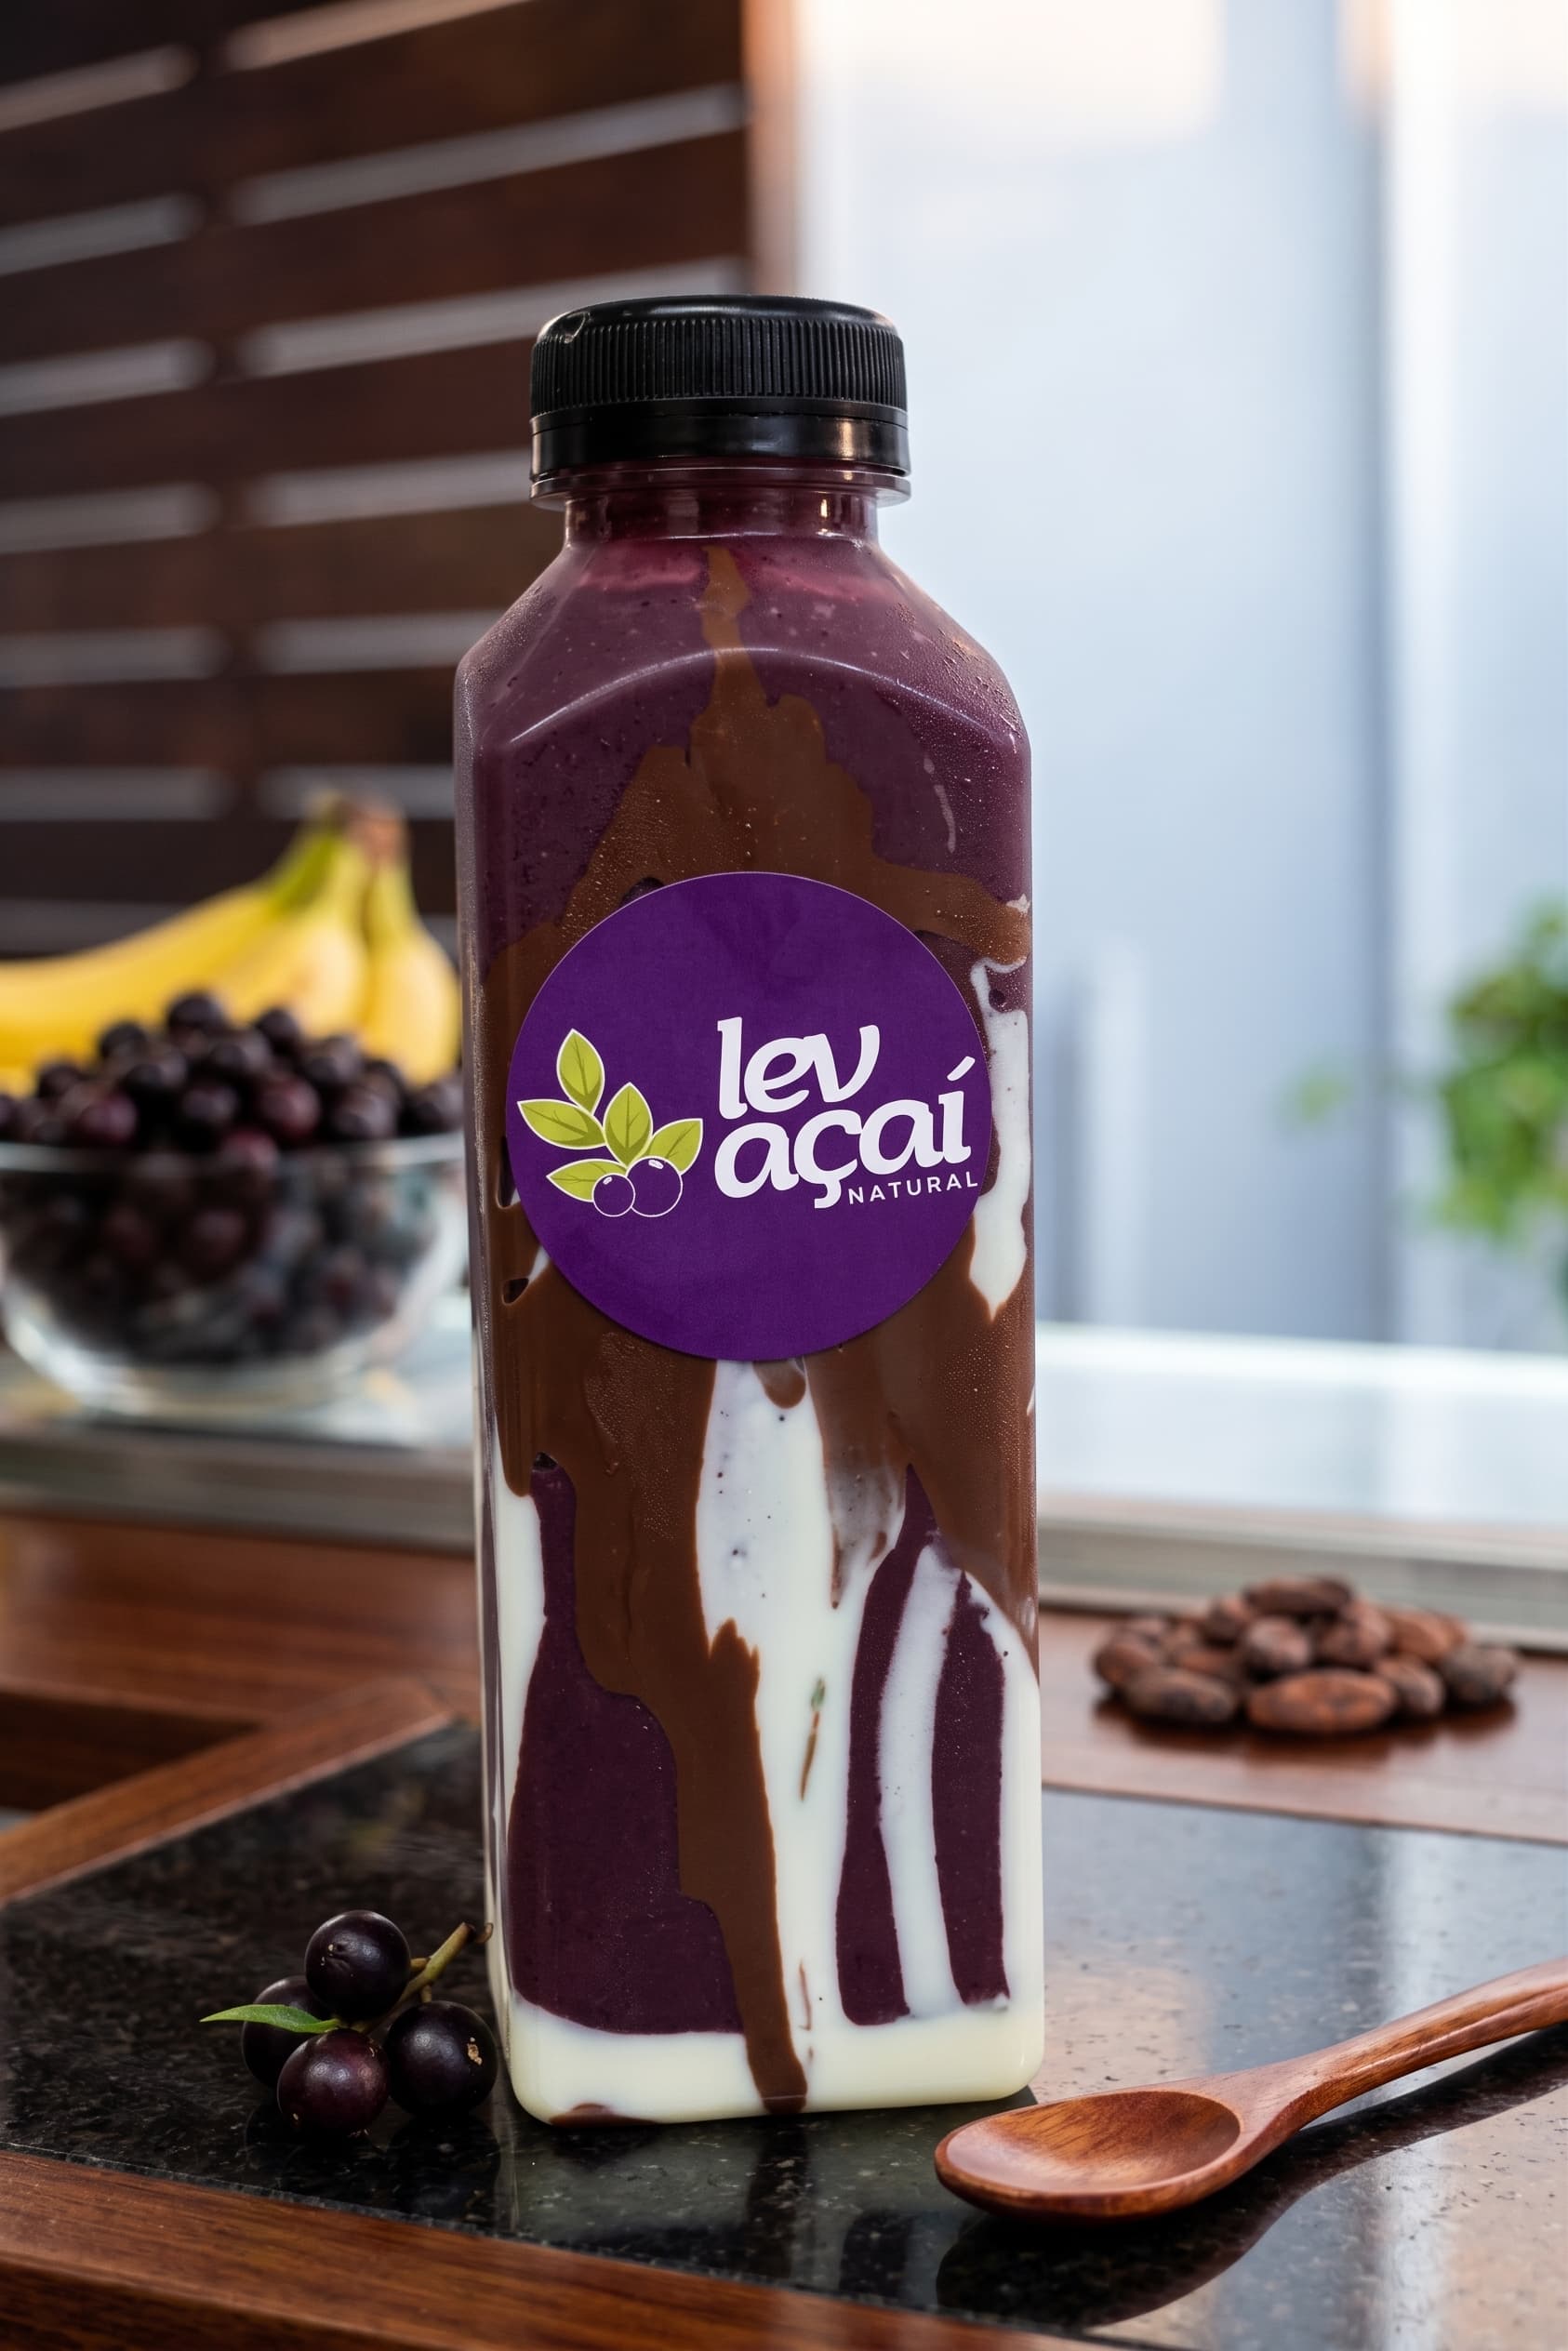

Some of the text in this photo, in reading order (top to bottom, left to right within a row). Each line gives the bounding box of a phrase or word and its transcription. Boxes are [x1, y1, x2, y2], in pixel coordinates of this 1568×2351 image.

[717, 1016, 881, 1120] lev
[714, 1056, 976, 1209] açaí
[848, 1171, 978, 1204] NATURAL
